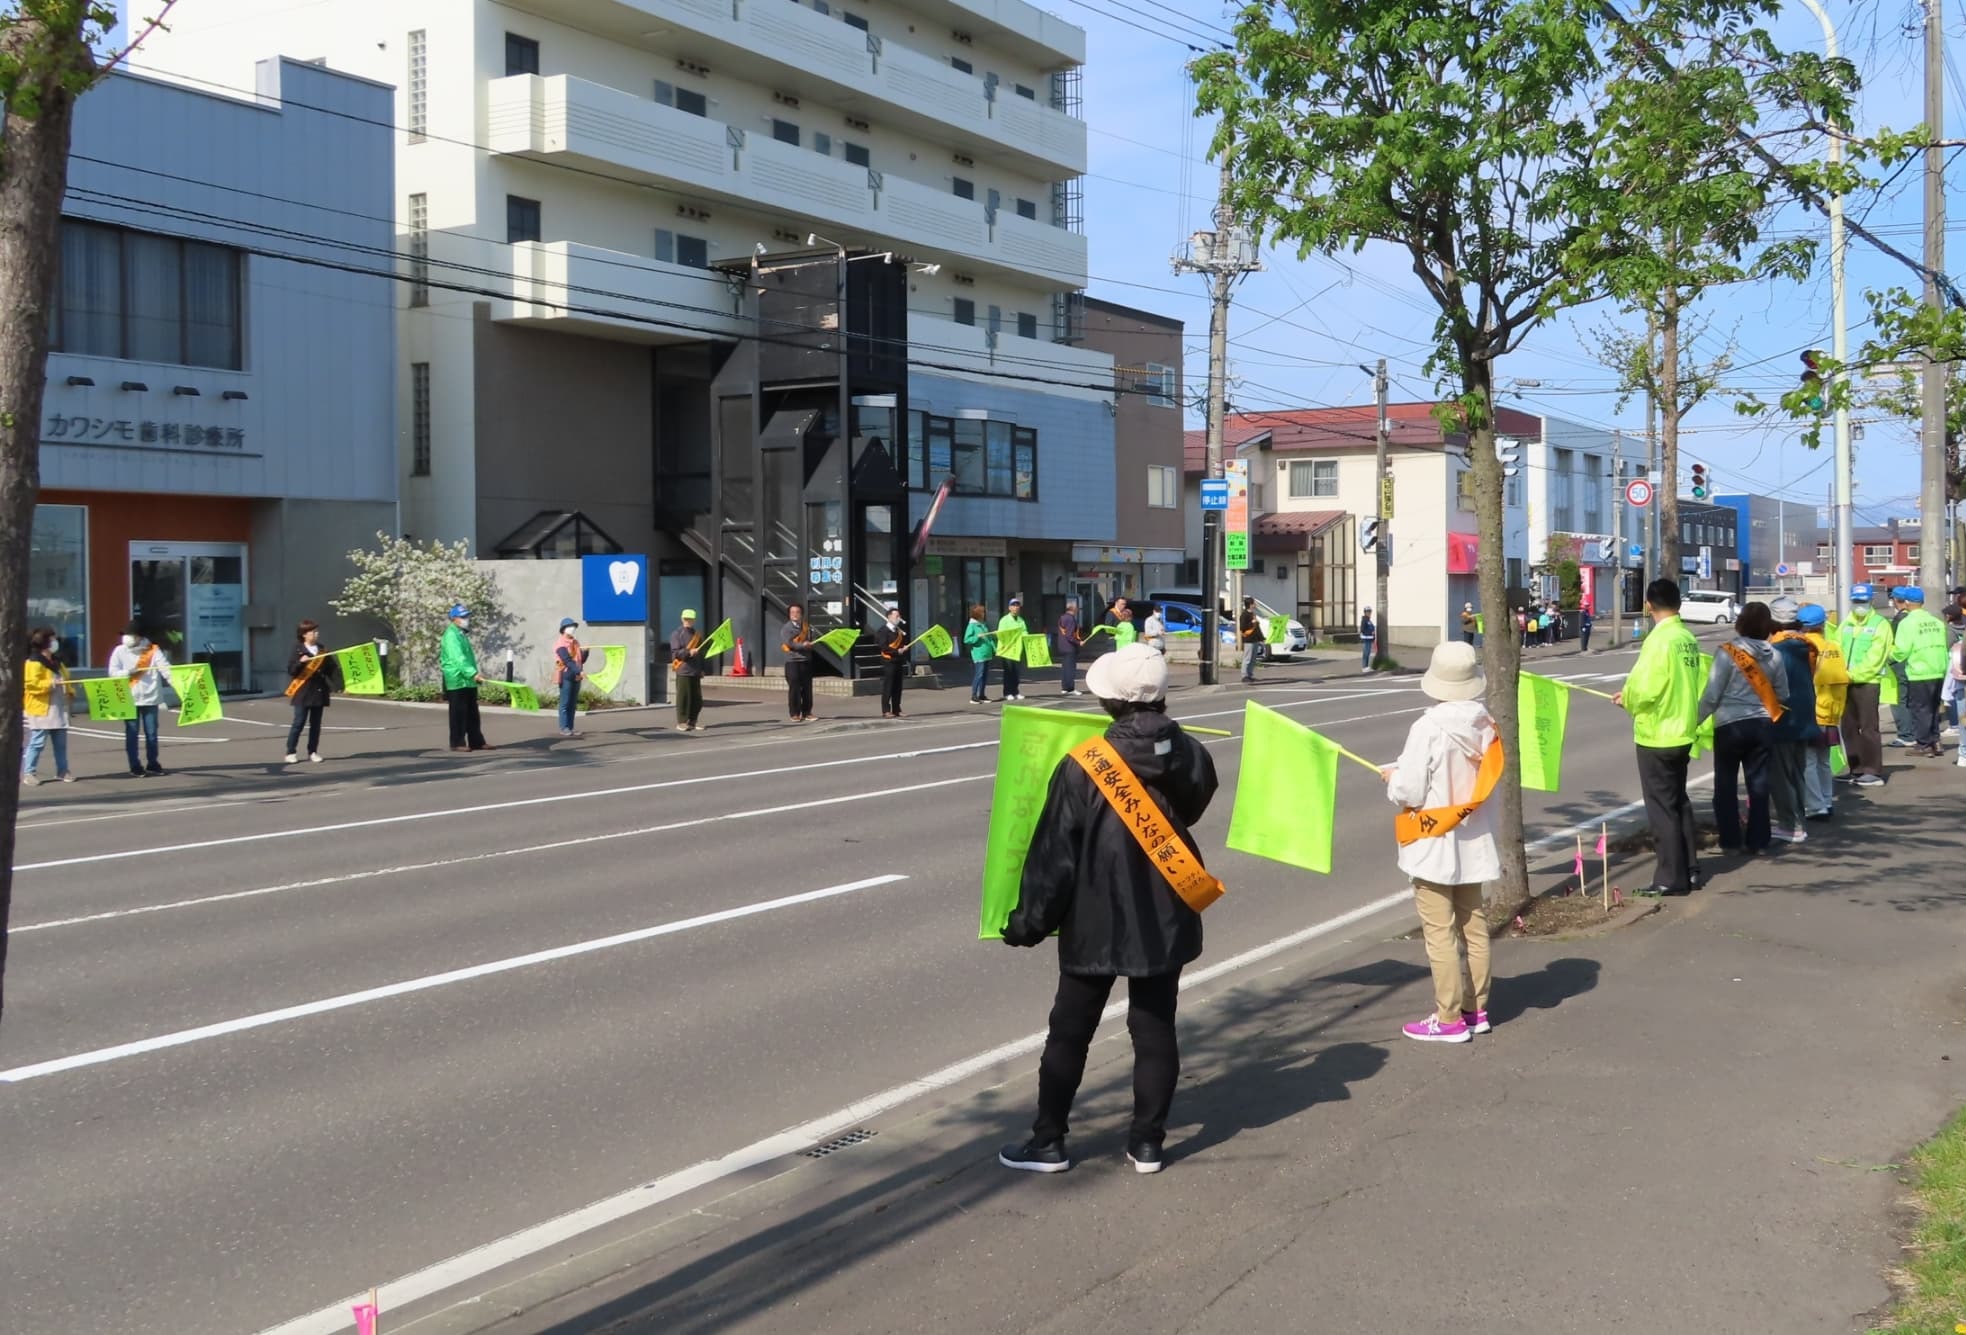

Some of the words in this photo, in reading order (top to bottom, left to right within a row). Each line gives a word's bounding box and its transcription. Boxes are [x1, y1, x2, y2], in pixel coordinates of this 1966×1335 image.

[47, 413, 246, 449] カワシモ歯科診療所
[1631, 486, 1648, 500] 50
[1082, 746, 1186, 875] 交通安全みんなの願い
